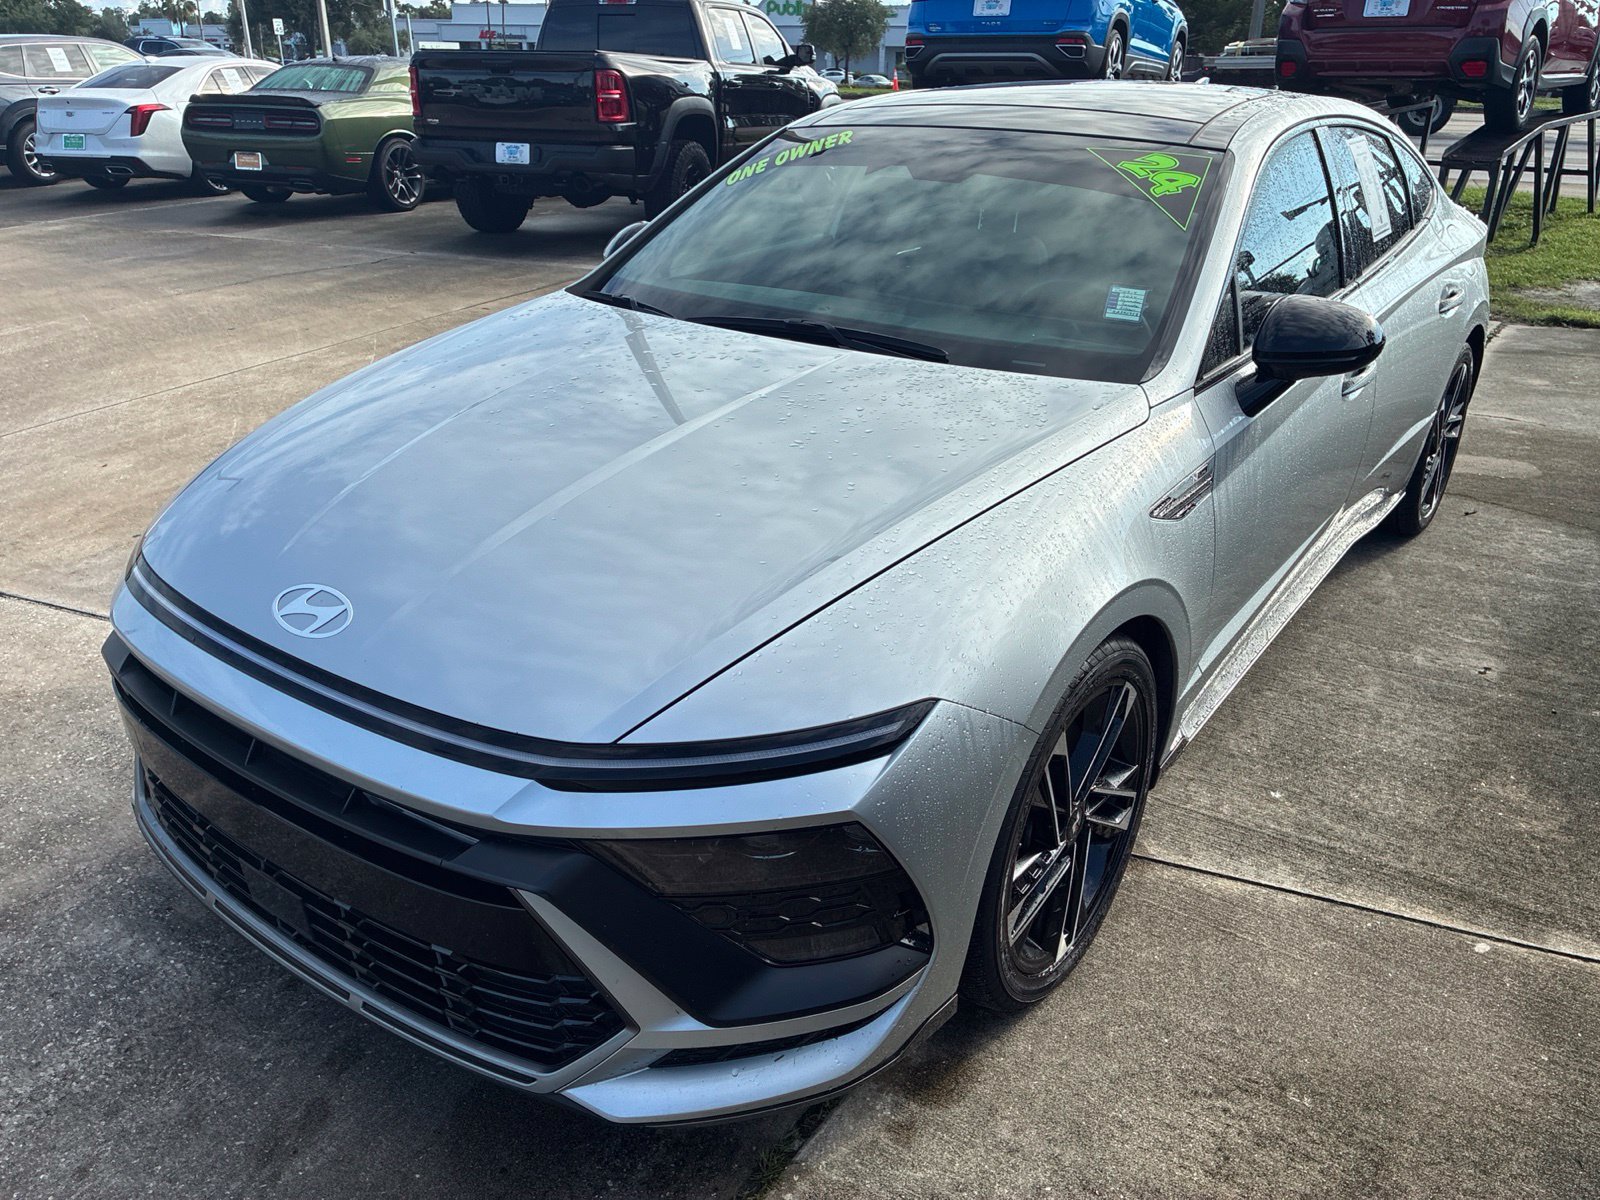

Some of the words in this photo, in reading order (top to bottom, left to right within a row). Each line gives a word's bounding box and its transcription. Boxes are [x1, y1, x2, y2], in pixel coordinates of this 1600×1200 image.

[479, 30, 496, 38] ACE
[461, 84, 542, 99] RAM
[726, 157, 770, 185] ONE
[774, 130, 854, 166] OWNER
[1116, 152, 1201, 197] 24
